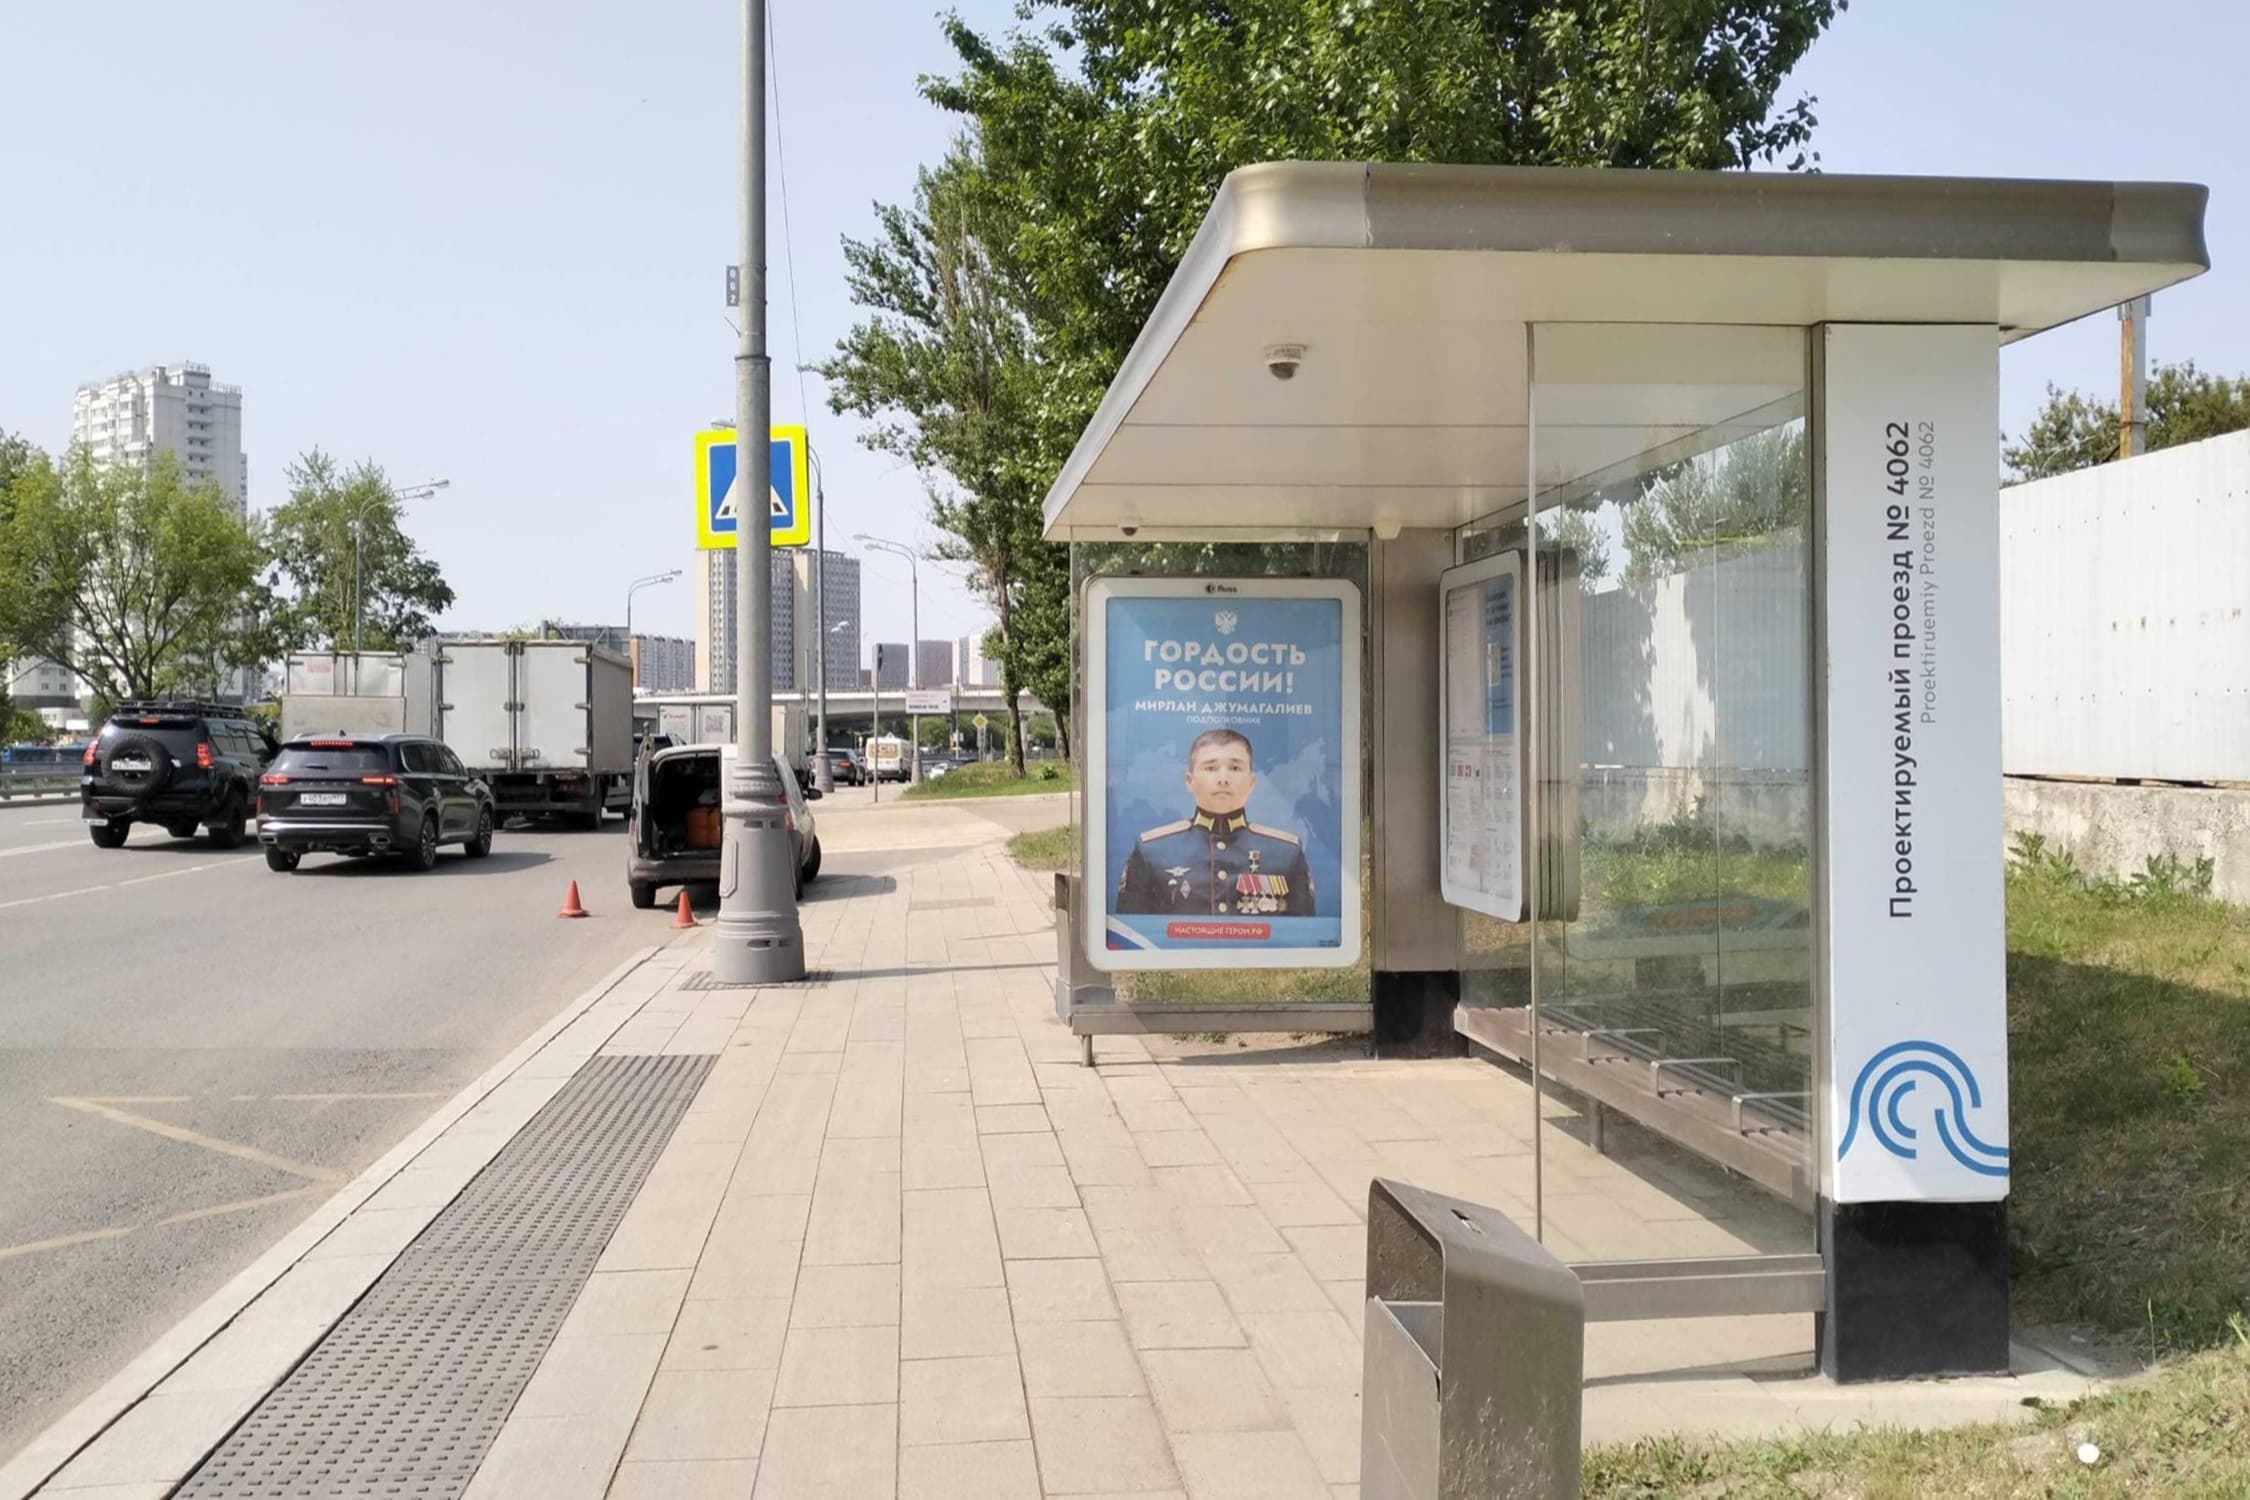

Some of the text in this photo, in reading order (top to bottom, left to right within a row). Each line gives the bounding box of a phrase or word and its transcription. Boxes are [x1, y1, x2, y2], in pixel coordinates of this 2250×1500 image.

[1918, 421, 1939, 723] Proektiruemiy Proezd № 4062
[1144, 639, 1306, 666] ГОРДОСТЬ
[1154, 668, 1294, 694] РОССИИ!
[1886, 422, 1917, 918] Проектируемый проезд № 4062
[1135, 699, 1313, 716] МИРЛАН ДЖУМАГАЛИЕВ
[1174, 926, 1263, 936] НАСТОЯЩИЕ ГЕРОИ РФ
